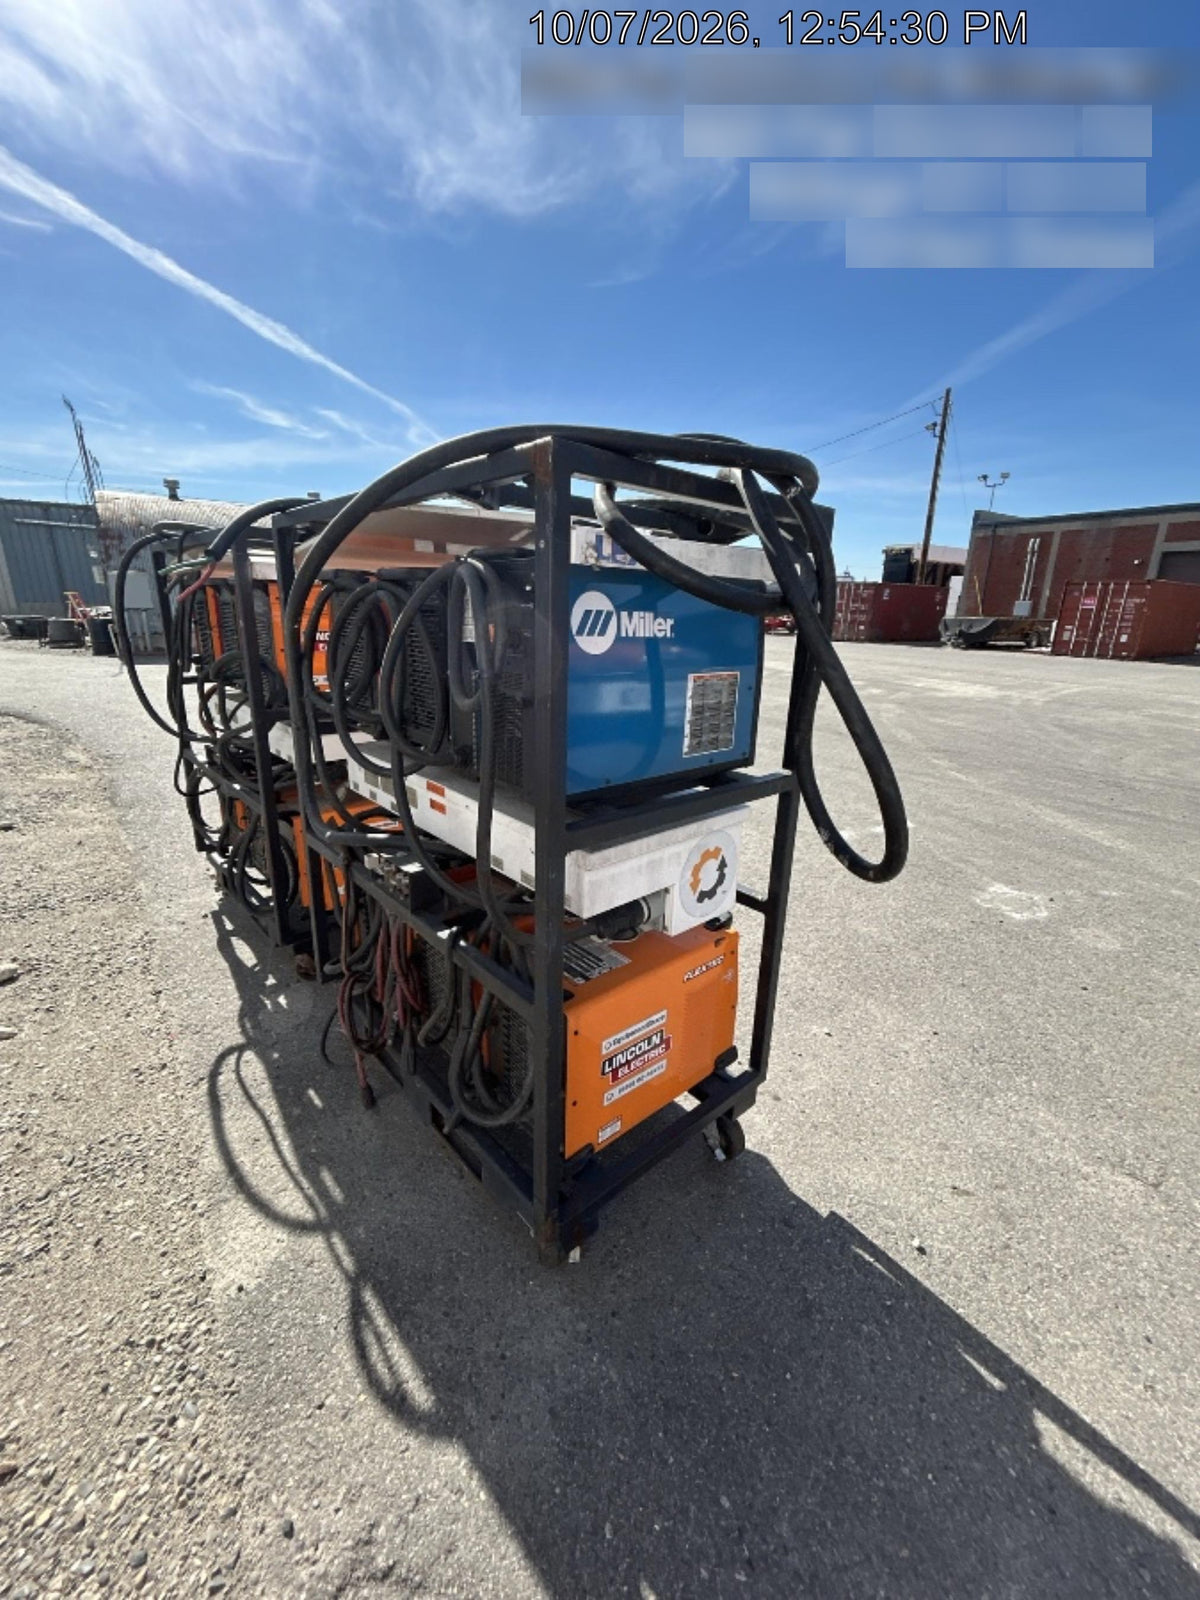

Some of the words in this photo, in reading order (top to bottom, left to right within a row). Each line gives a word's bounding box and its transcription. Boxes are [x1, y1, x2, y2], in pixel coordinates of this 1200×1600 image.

[620, 610, 675, 638] Miller
[604, 1031, 662, 1074] LINCOLN
[617, 1044, 666, 1078] ELECTRIC
